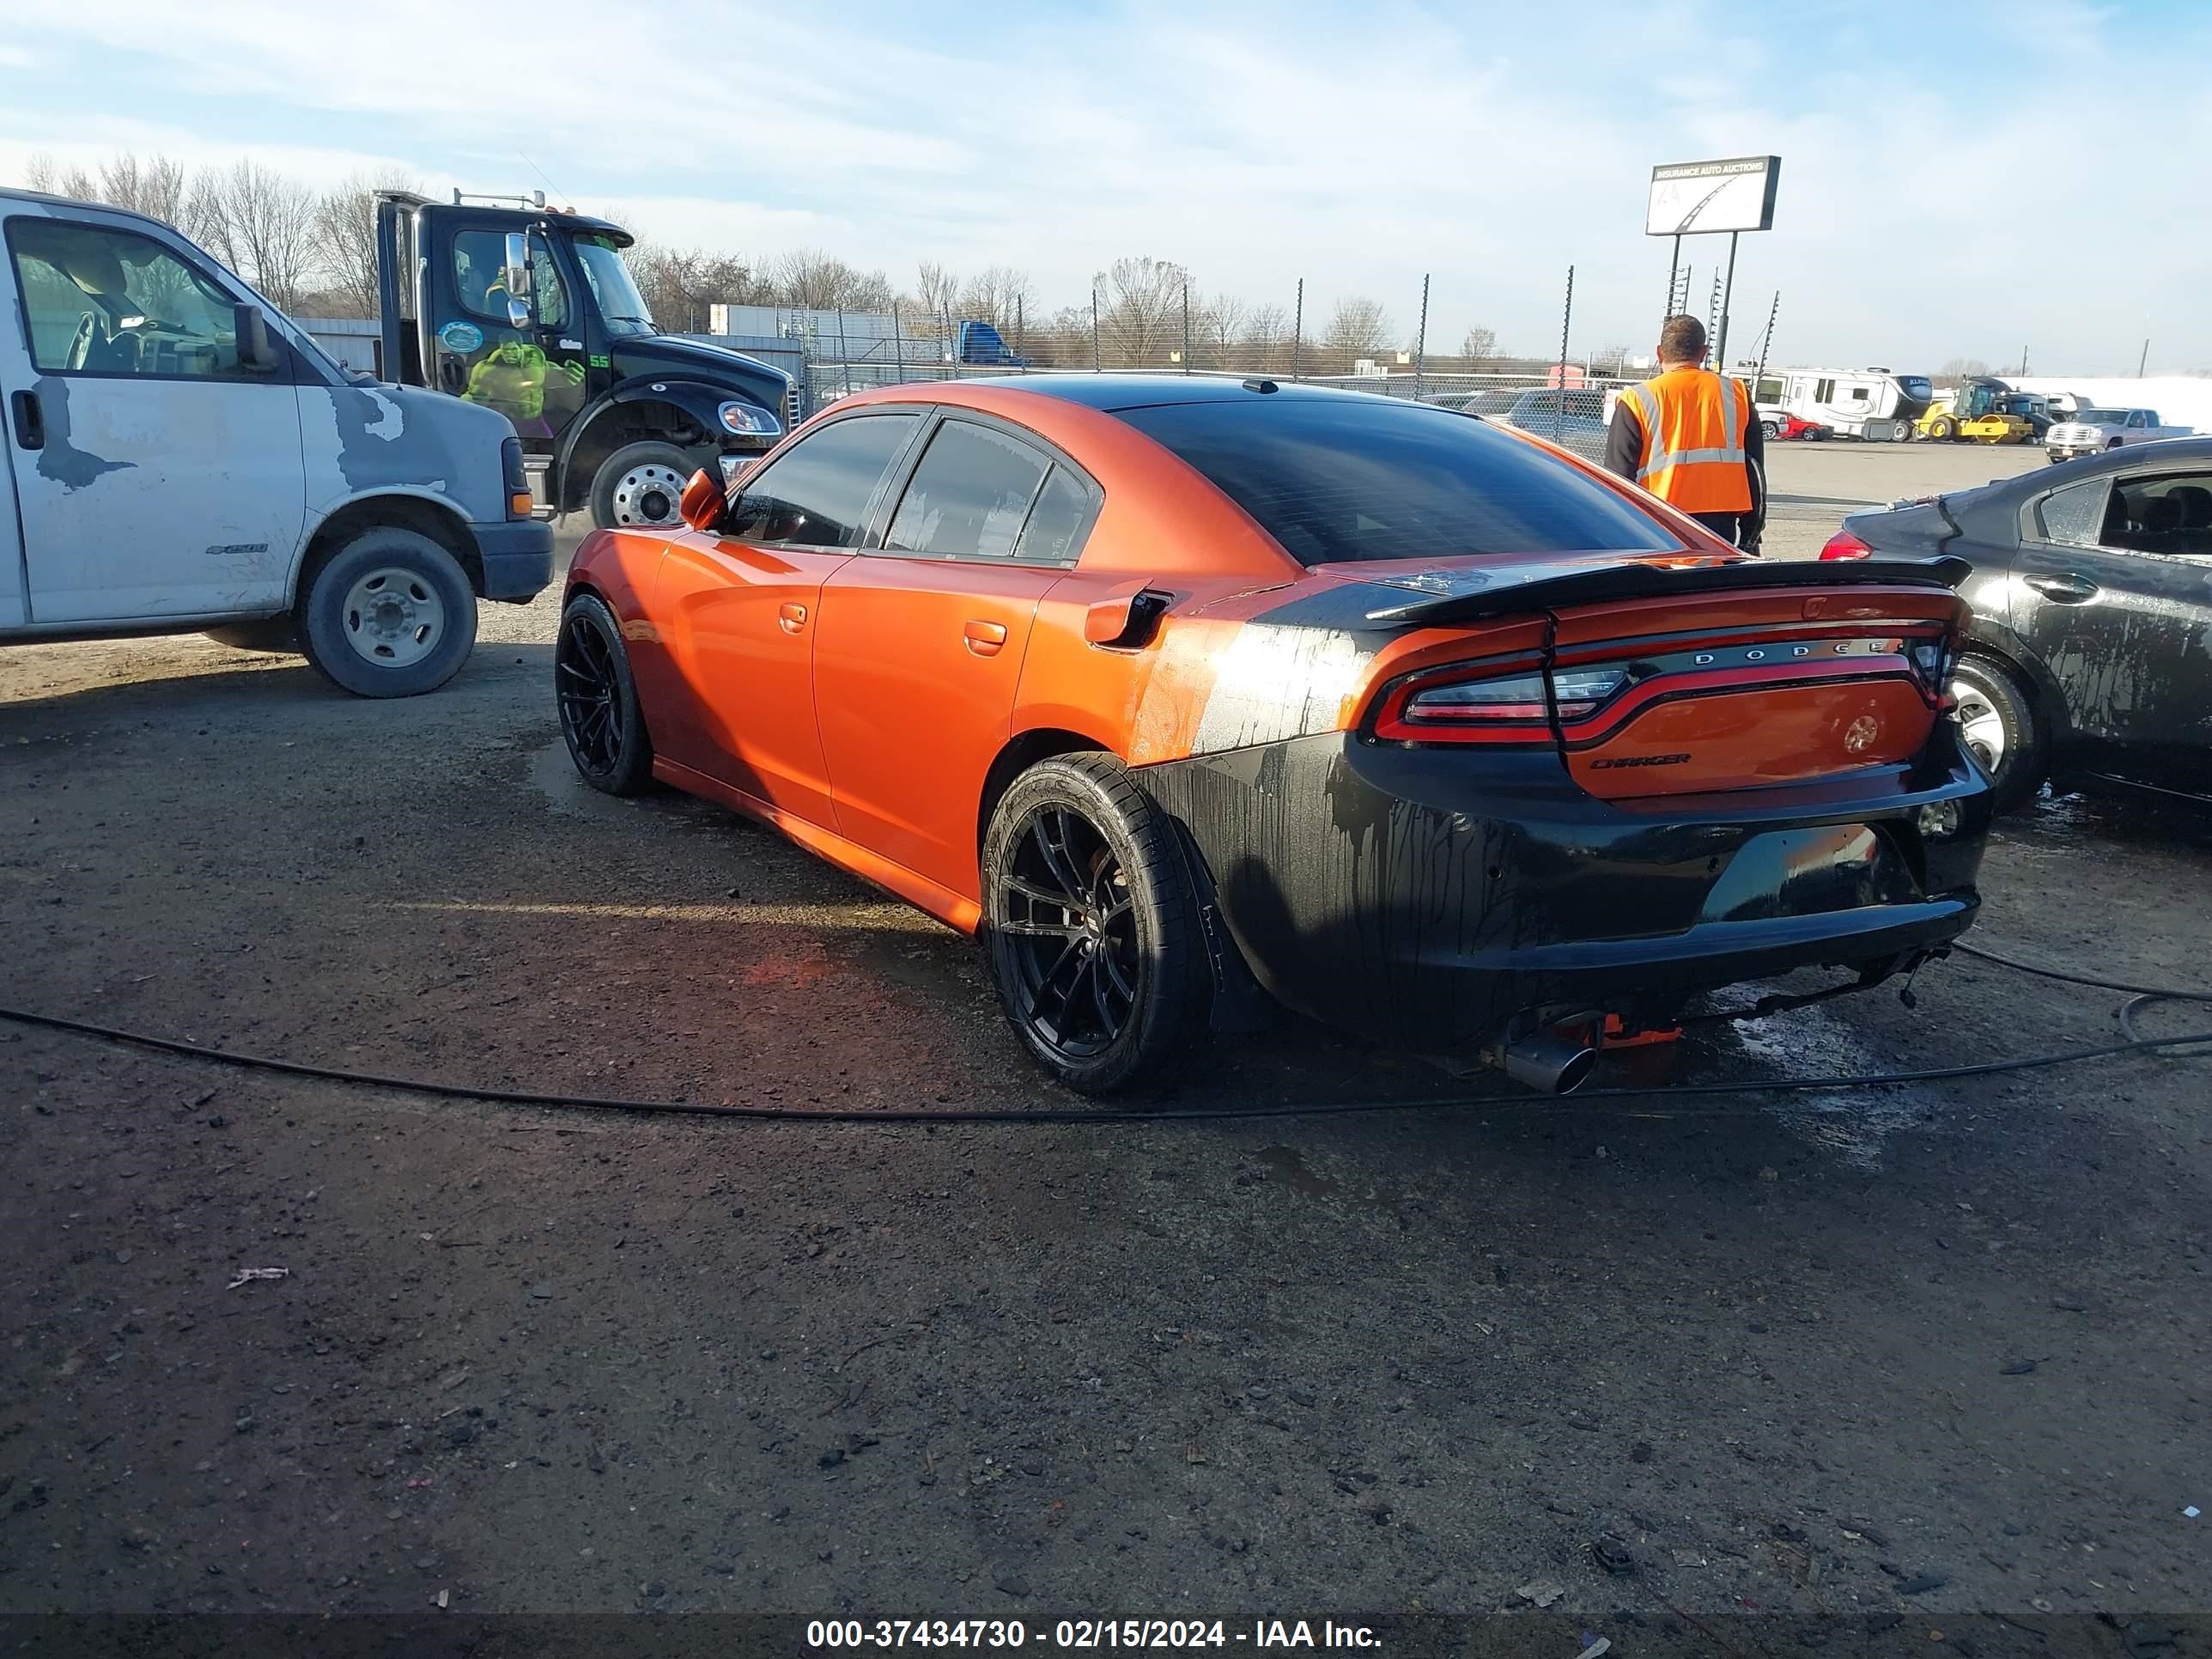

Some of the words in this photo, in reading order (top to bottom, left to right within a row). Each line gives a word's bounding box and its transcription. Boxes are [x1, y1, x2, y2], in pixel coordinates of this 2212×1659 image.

[1656, 167, 1699, 179] INSURANCE
[1701, 165, 1722, 175] AUTO
[1723, 161, 1764, 173] AUCTIONS
[1693, 641, 1886, 665] DODGE
[1590, 753, 1692, 769] CHARGER
